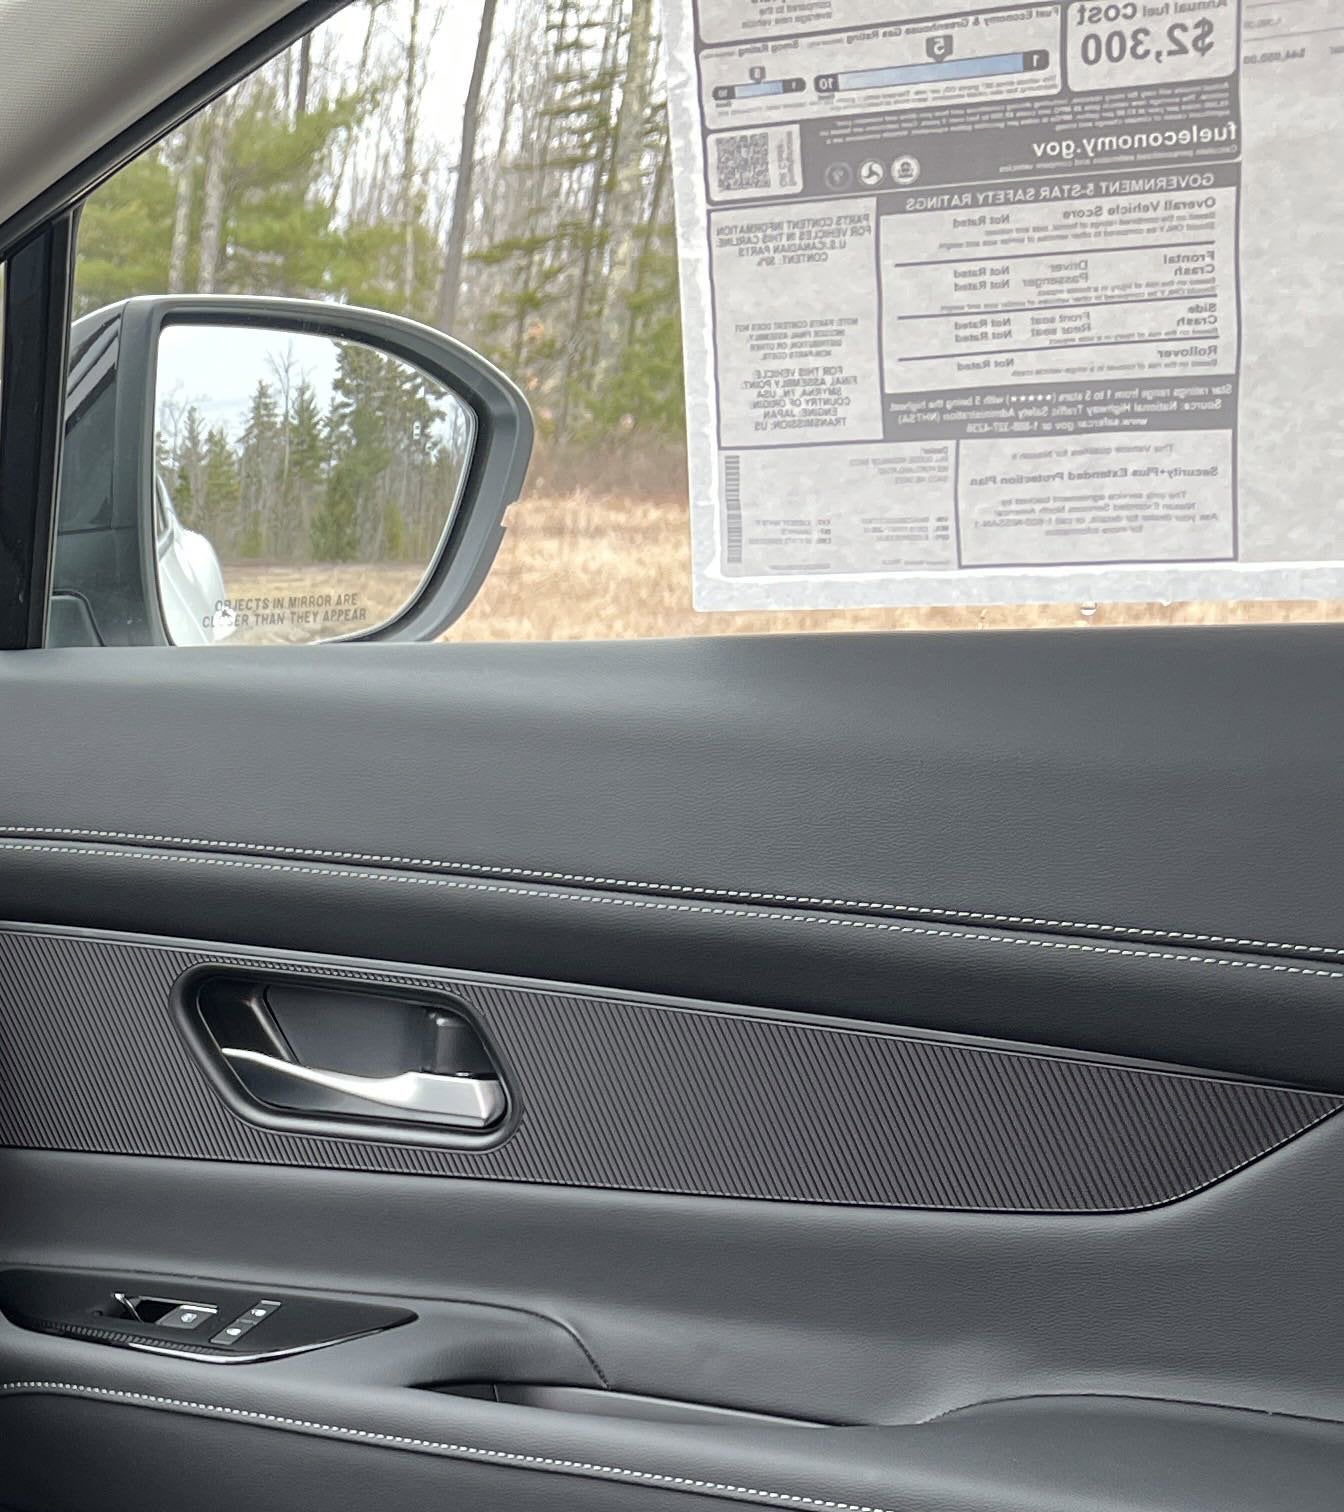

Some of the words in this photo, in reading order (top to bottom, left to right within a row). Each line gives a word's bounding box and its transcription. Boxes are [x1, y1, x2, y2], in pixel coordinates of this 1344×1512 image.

[273, 598, 285, 610] IN
[288, 595, 332, 609] MIRROR
[335, 594, 358, 606] ARE
[255, 612, 286, 626] THAN
[290, 610, 318, 624] THEY
[323, 608, 367, 622] APPEAR
